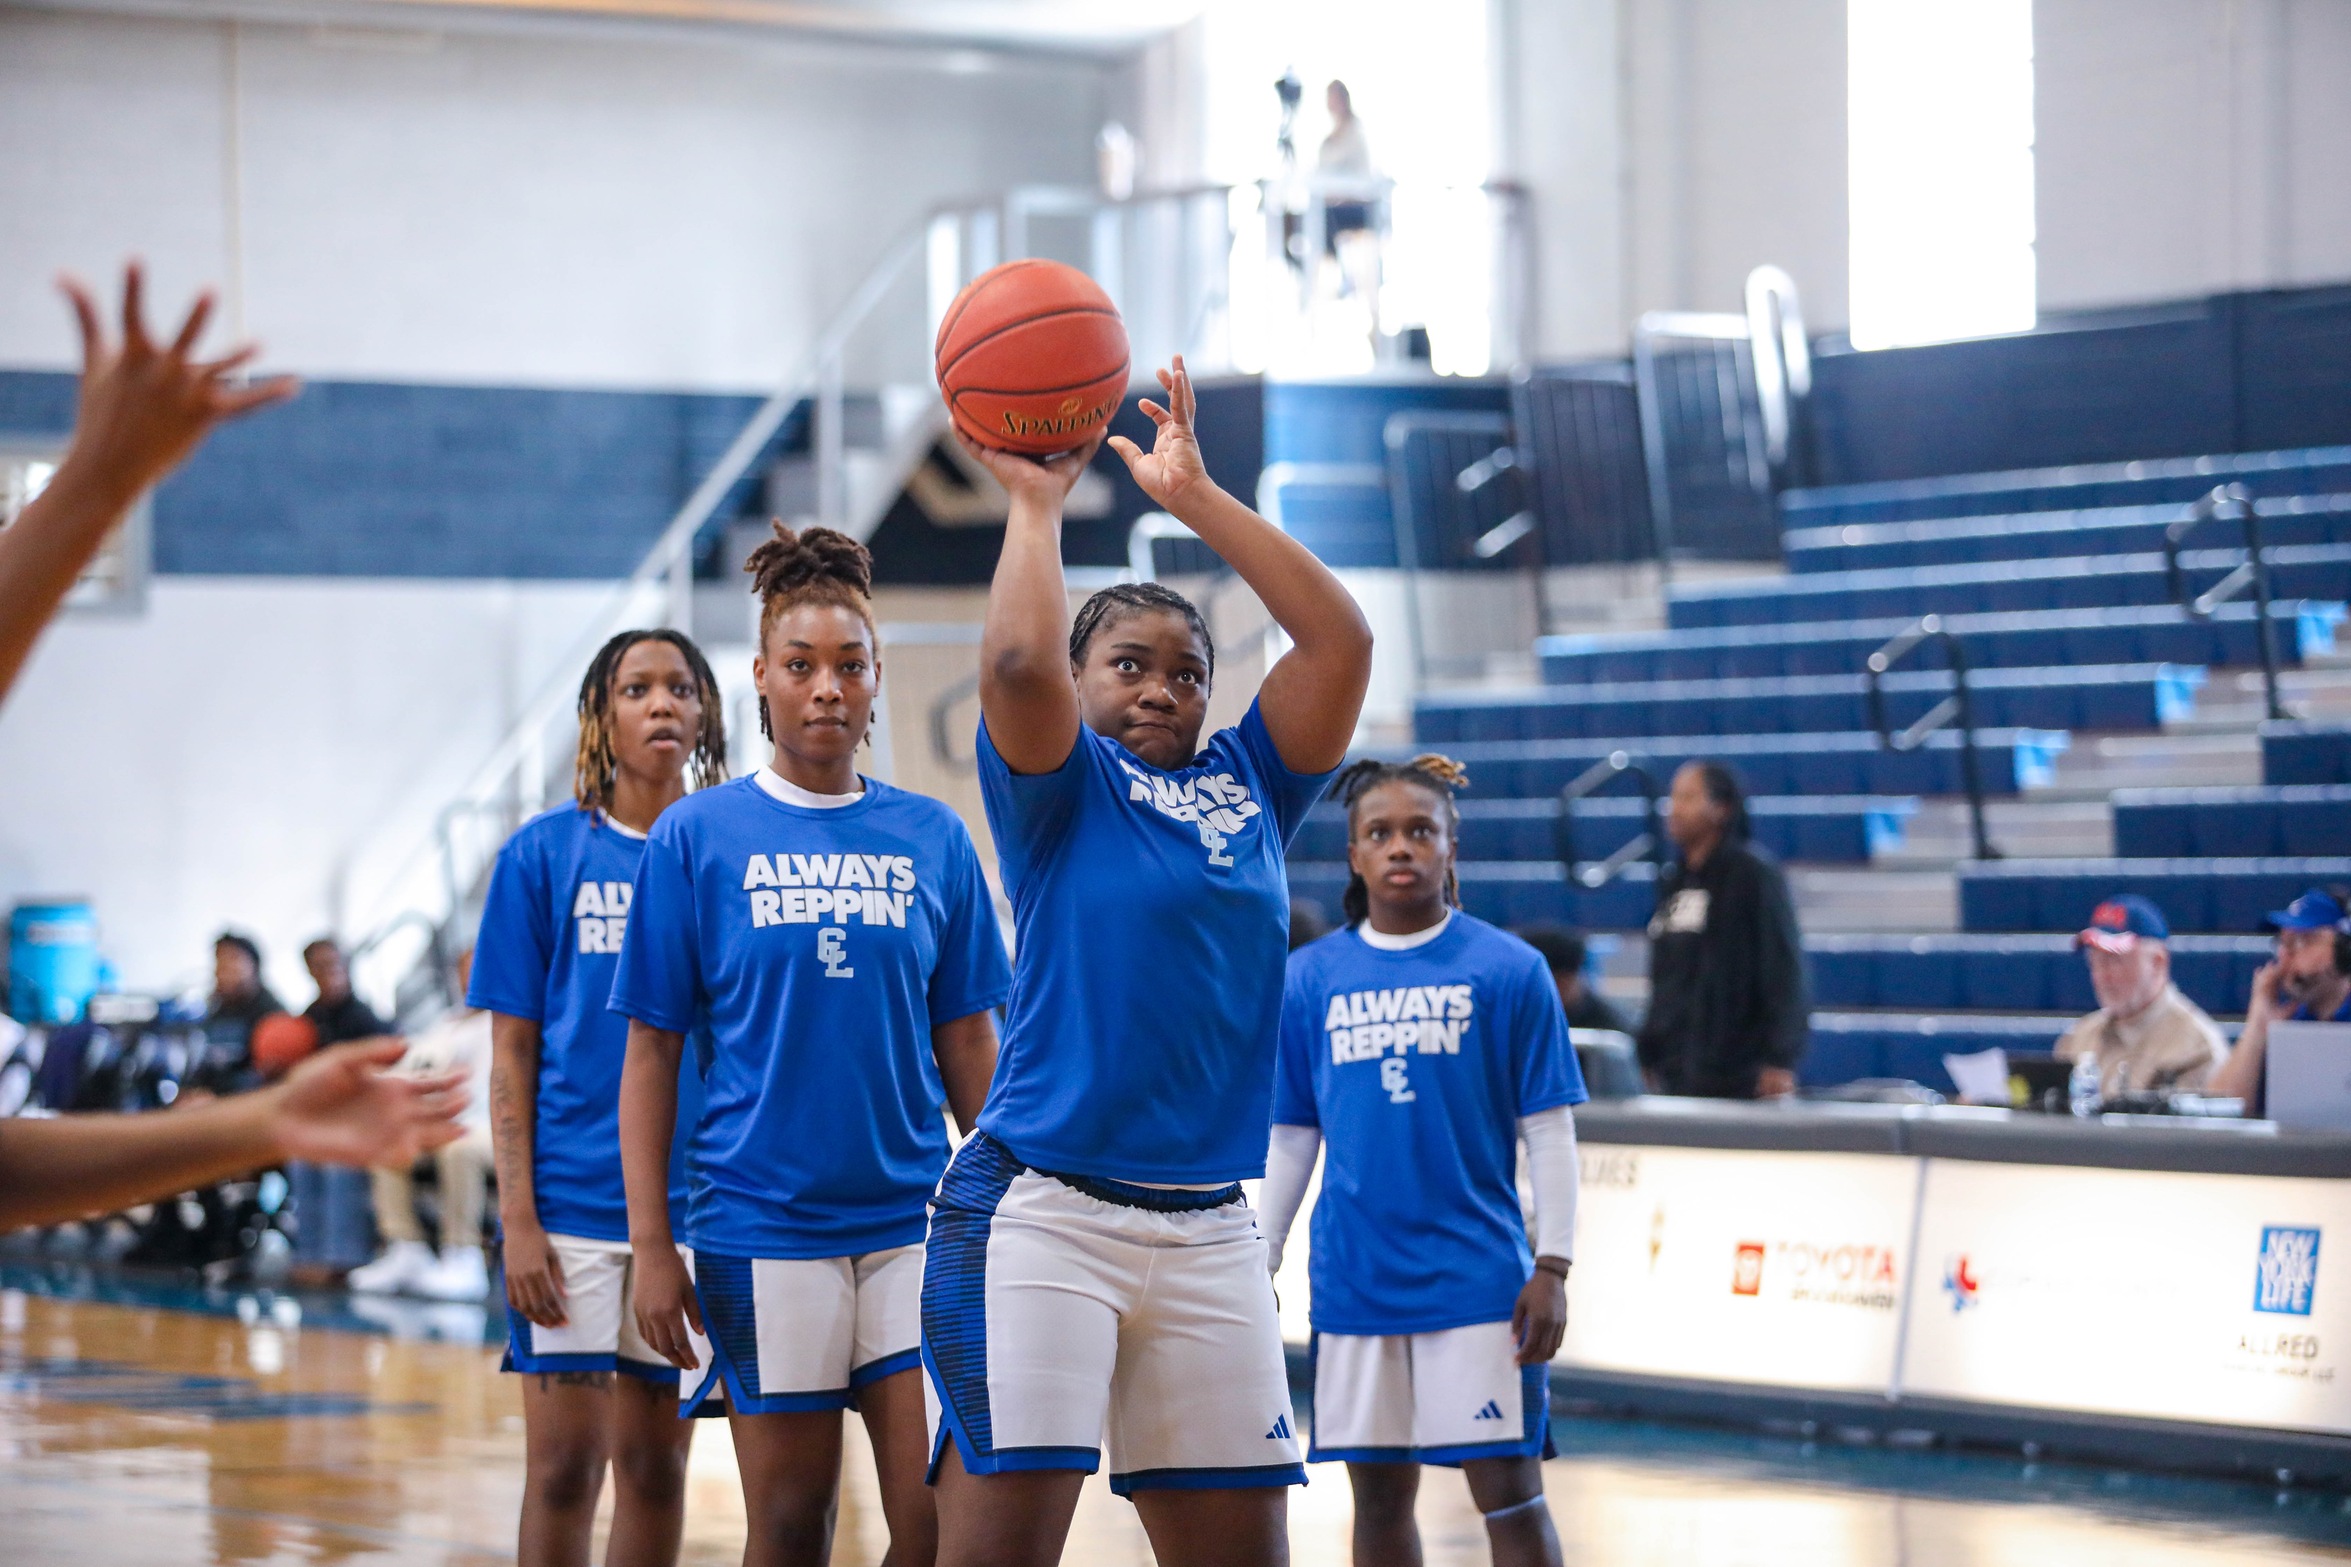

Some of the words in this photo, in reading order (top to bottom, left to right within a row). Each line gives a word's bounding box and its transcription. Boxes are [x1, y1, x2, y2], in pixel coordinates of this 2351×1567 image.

[743, 853, 917, 892] ALWAYS
[750, 888, 915, 929] REPPIN'
[1325, 984, 1474, 1031] ALWAYS
[1330, 1018, 1471, 1066] REPPIN'
[2260, 1279, 2308, 1312] LIFE
